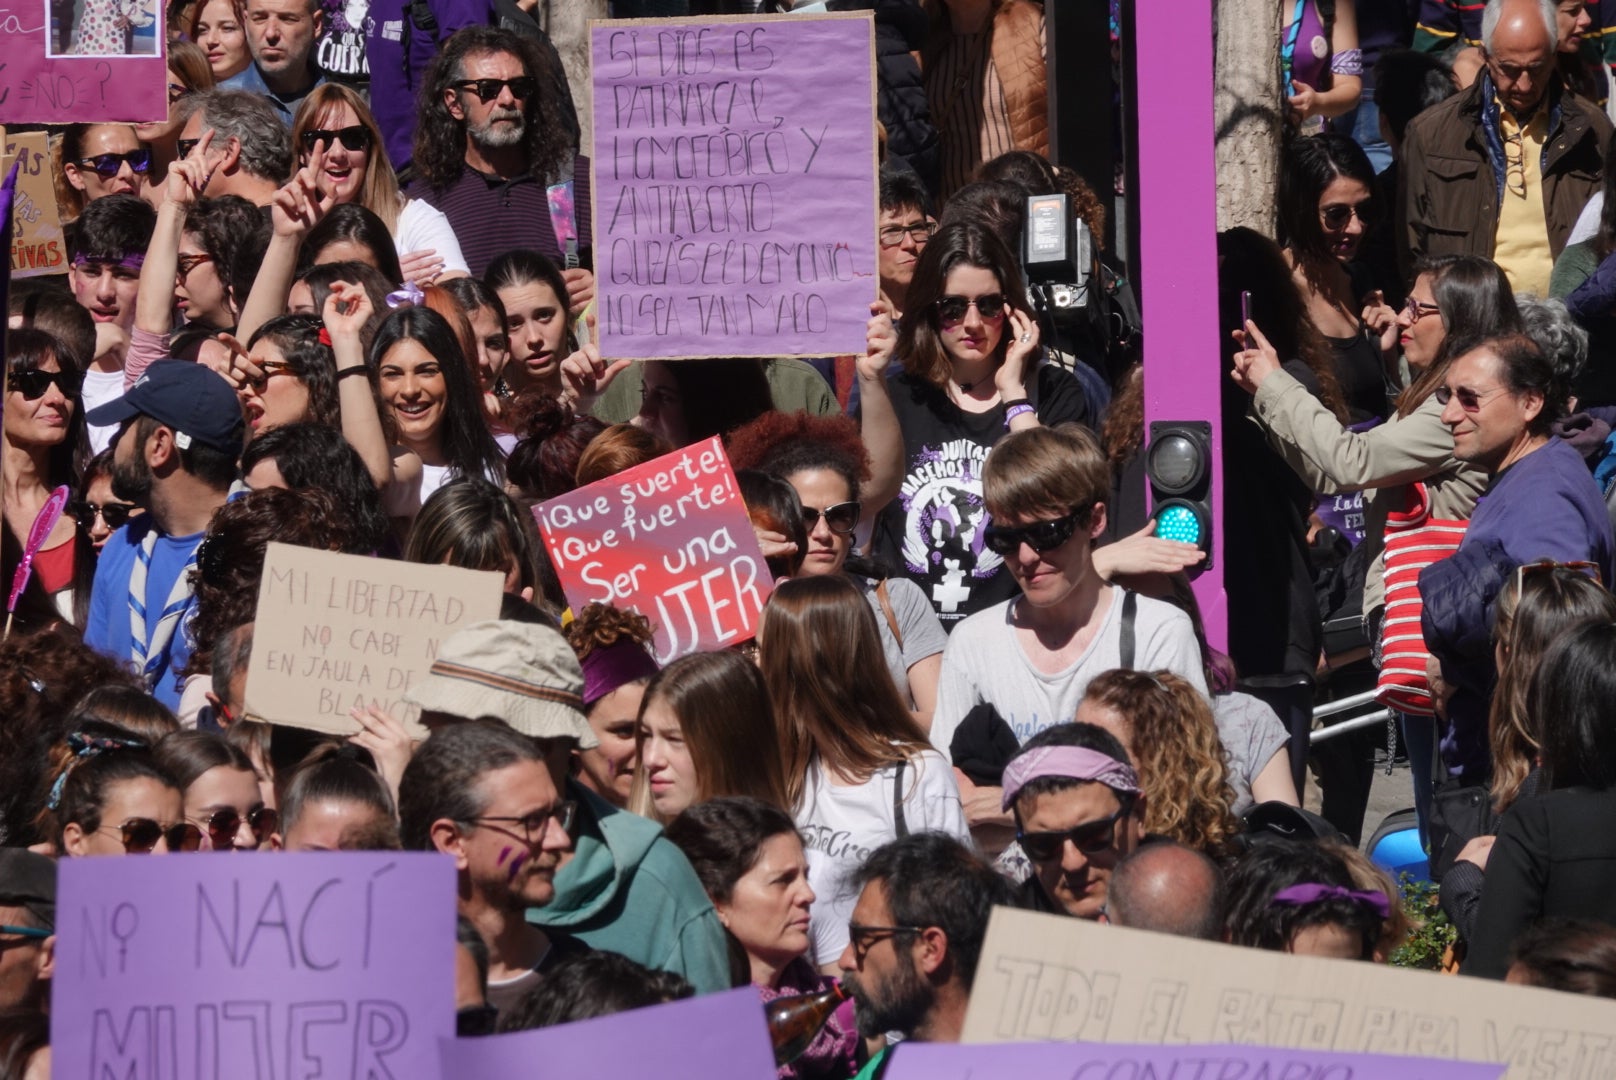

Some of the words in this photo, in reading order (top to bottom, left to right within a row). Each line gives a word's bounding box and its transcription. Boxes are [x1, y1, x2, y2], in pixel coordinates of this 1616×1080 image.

[800, 124, 829, 174] Y
[608, 181, 774, 235] ANTIABORTO
[688, 294, 740, 337] TAN
[619, 438, 727, 505] suerte!
[620, 473, 736, 542] fuerte!
[268, 565, 309, 606] MI
[327, 576, 466, 627] LIBERTAD
[580, 561, 647, 605] Ser
[662, 526, 738, 575] una
[630, 555, 764, 665] UJER
[267, 651, 295, 677] EN
[303, 656, 372, 684] JAULA
[195, 861, 397, 972] NACÍ
